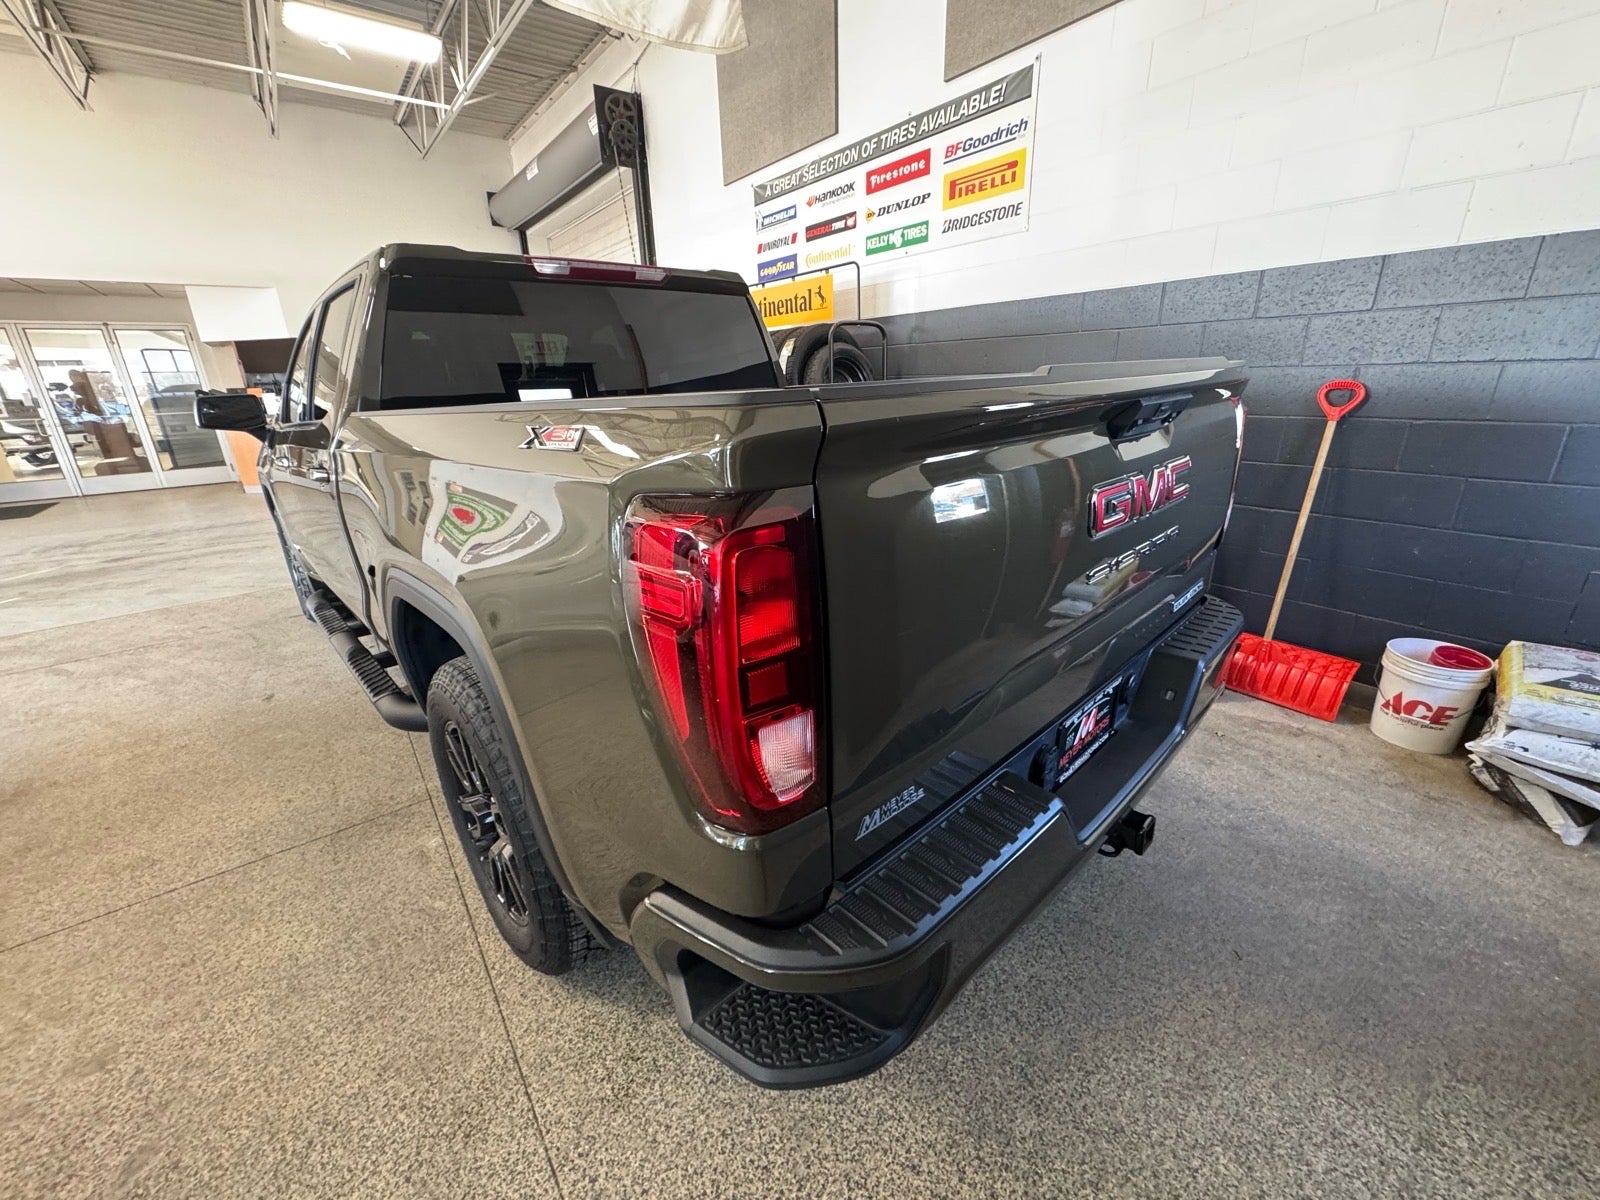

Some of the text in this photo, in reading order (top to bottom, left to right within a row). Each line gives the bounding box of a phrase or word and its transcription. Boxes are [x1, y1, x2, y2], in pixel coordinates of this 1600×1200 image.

[765, 82, 1007, 197] A GREAT SELECTION OF TIRES AVAILABLE!
[945, 118, 1028, 159] BFGoodrich
[870, 159, 926, 189] Firestone
[949, 160, 1018, 200] PIRELLI
[763, 208, 796, 226] MICHELIN
[877, 192, 931, 217] DUNLOP
[941, 201, 1024, 234] BRIDGESTONE
[762, 235, 790, 252] UNIROYAL
[866, 233, 889, 250] KELLY
[903, 224, 927, 240] TIRES
[760, 261, 795, 276] GOODYEAR
[805, 244, 851, 268] Continental
[1087, 455, 1192, 541] GMC
[1381, 691, 1459, 726] ACE
[881, 785, 915, 814] MEYER
[881, 788, 926, 822] MOTORS
